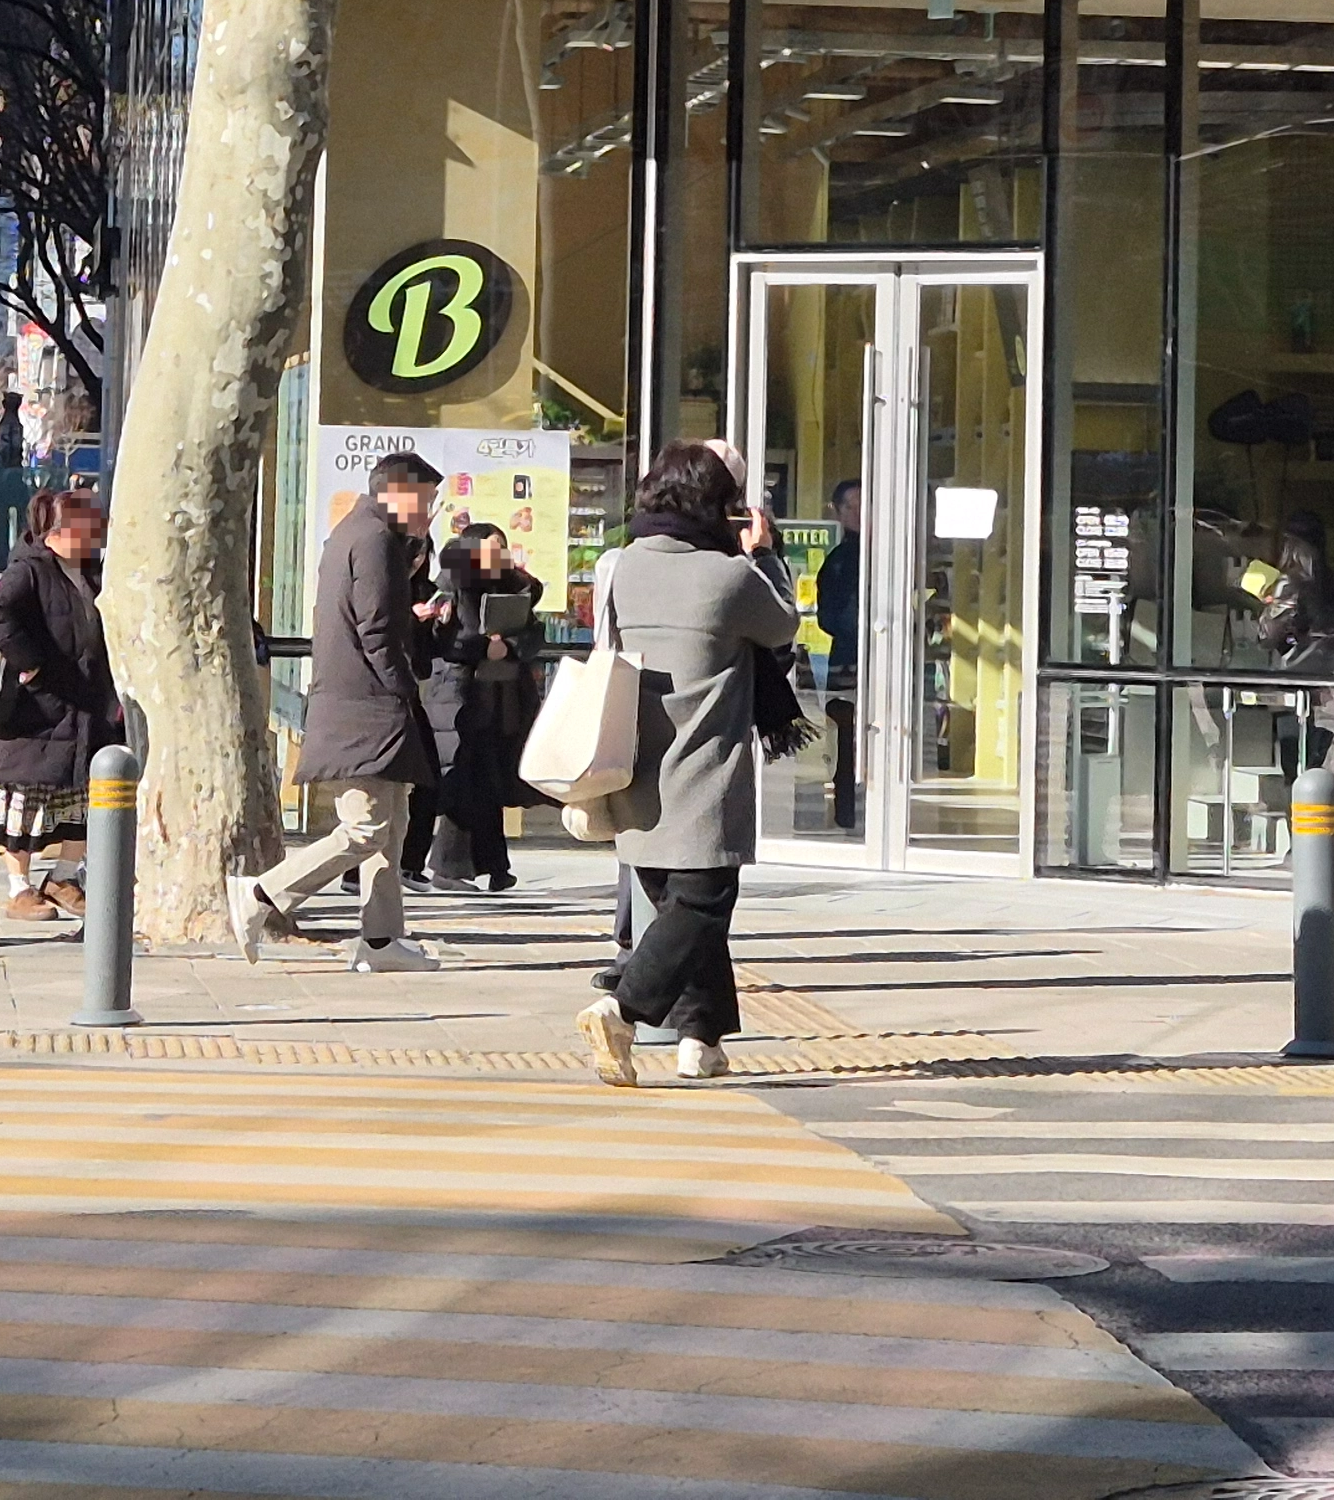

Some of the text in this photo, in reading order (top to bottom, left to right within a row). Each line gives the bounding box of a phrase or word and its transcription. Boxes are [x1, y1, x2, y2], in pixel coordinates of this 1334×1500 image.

[367, 253, 487, 379] B
[345, 434, 415, 452] GRAND
[335, 454, 381, 472] OPE
[782, 528, 830, 545] ETTER
